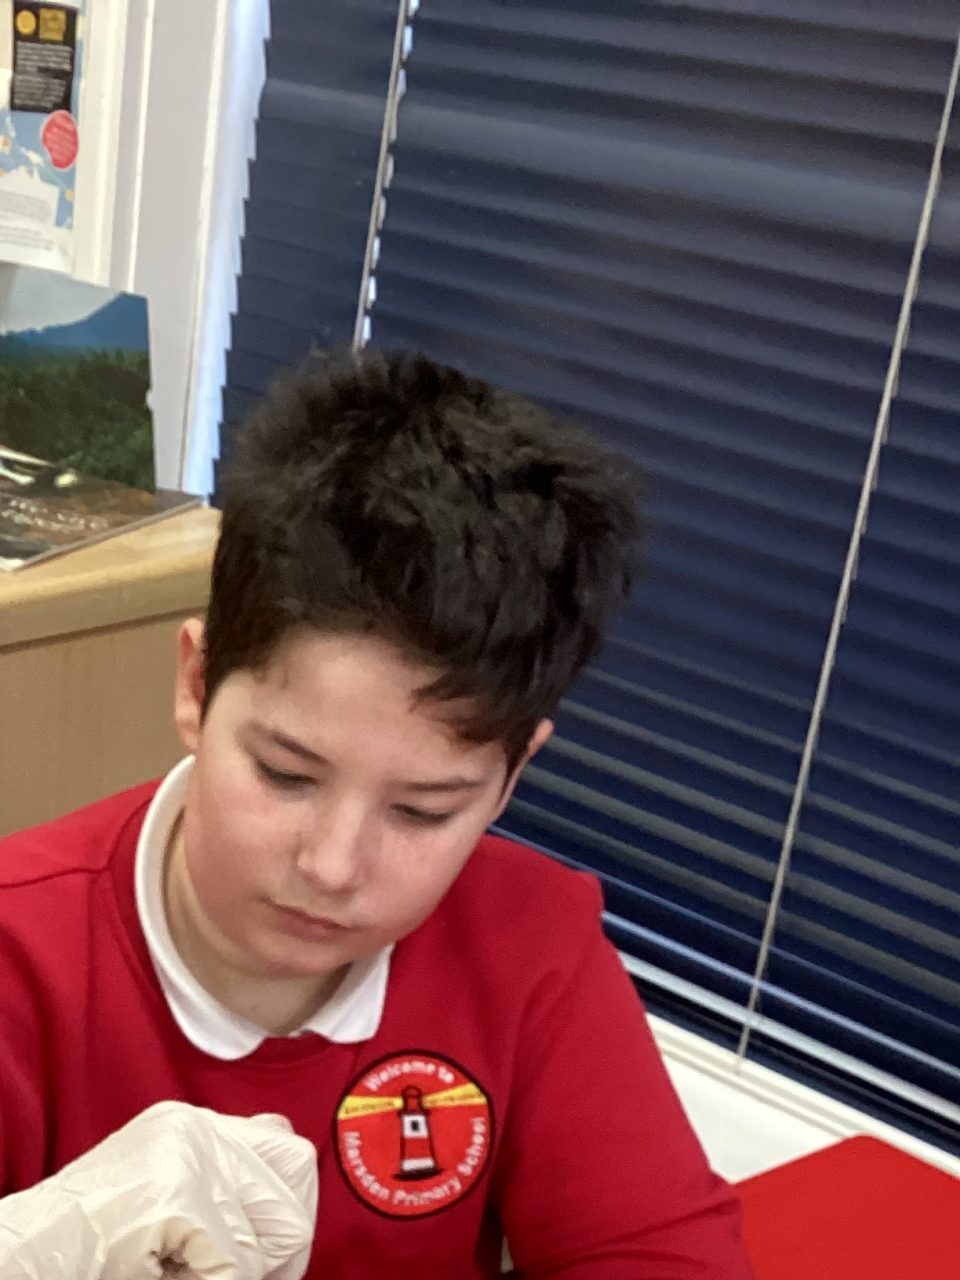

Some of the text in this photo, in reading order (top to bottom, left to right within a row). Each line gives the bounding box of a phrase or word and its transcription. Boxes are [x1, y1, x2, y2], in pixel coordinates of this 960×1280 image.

[363, 1061, 455, 1091] Welcome to
[393, 1177, 462, 1206] Primary
[457, 1117, 486, 1176] School
